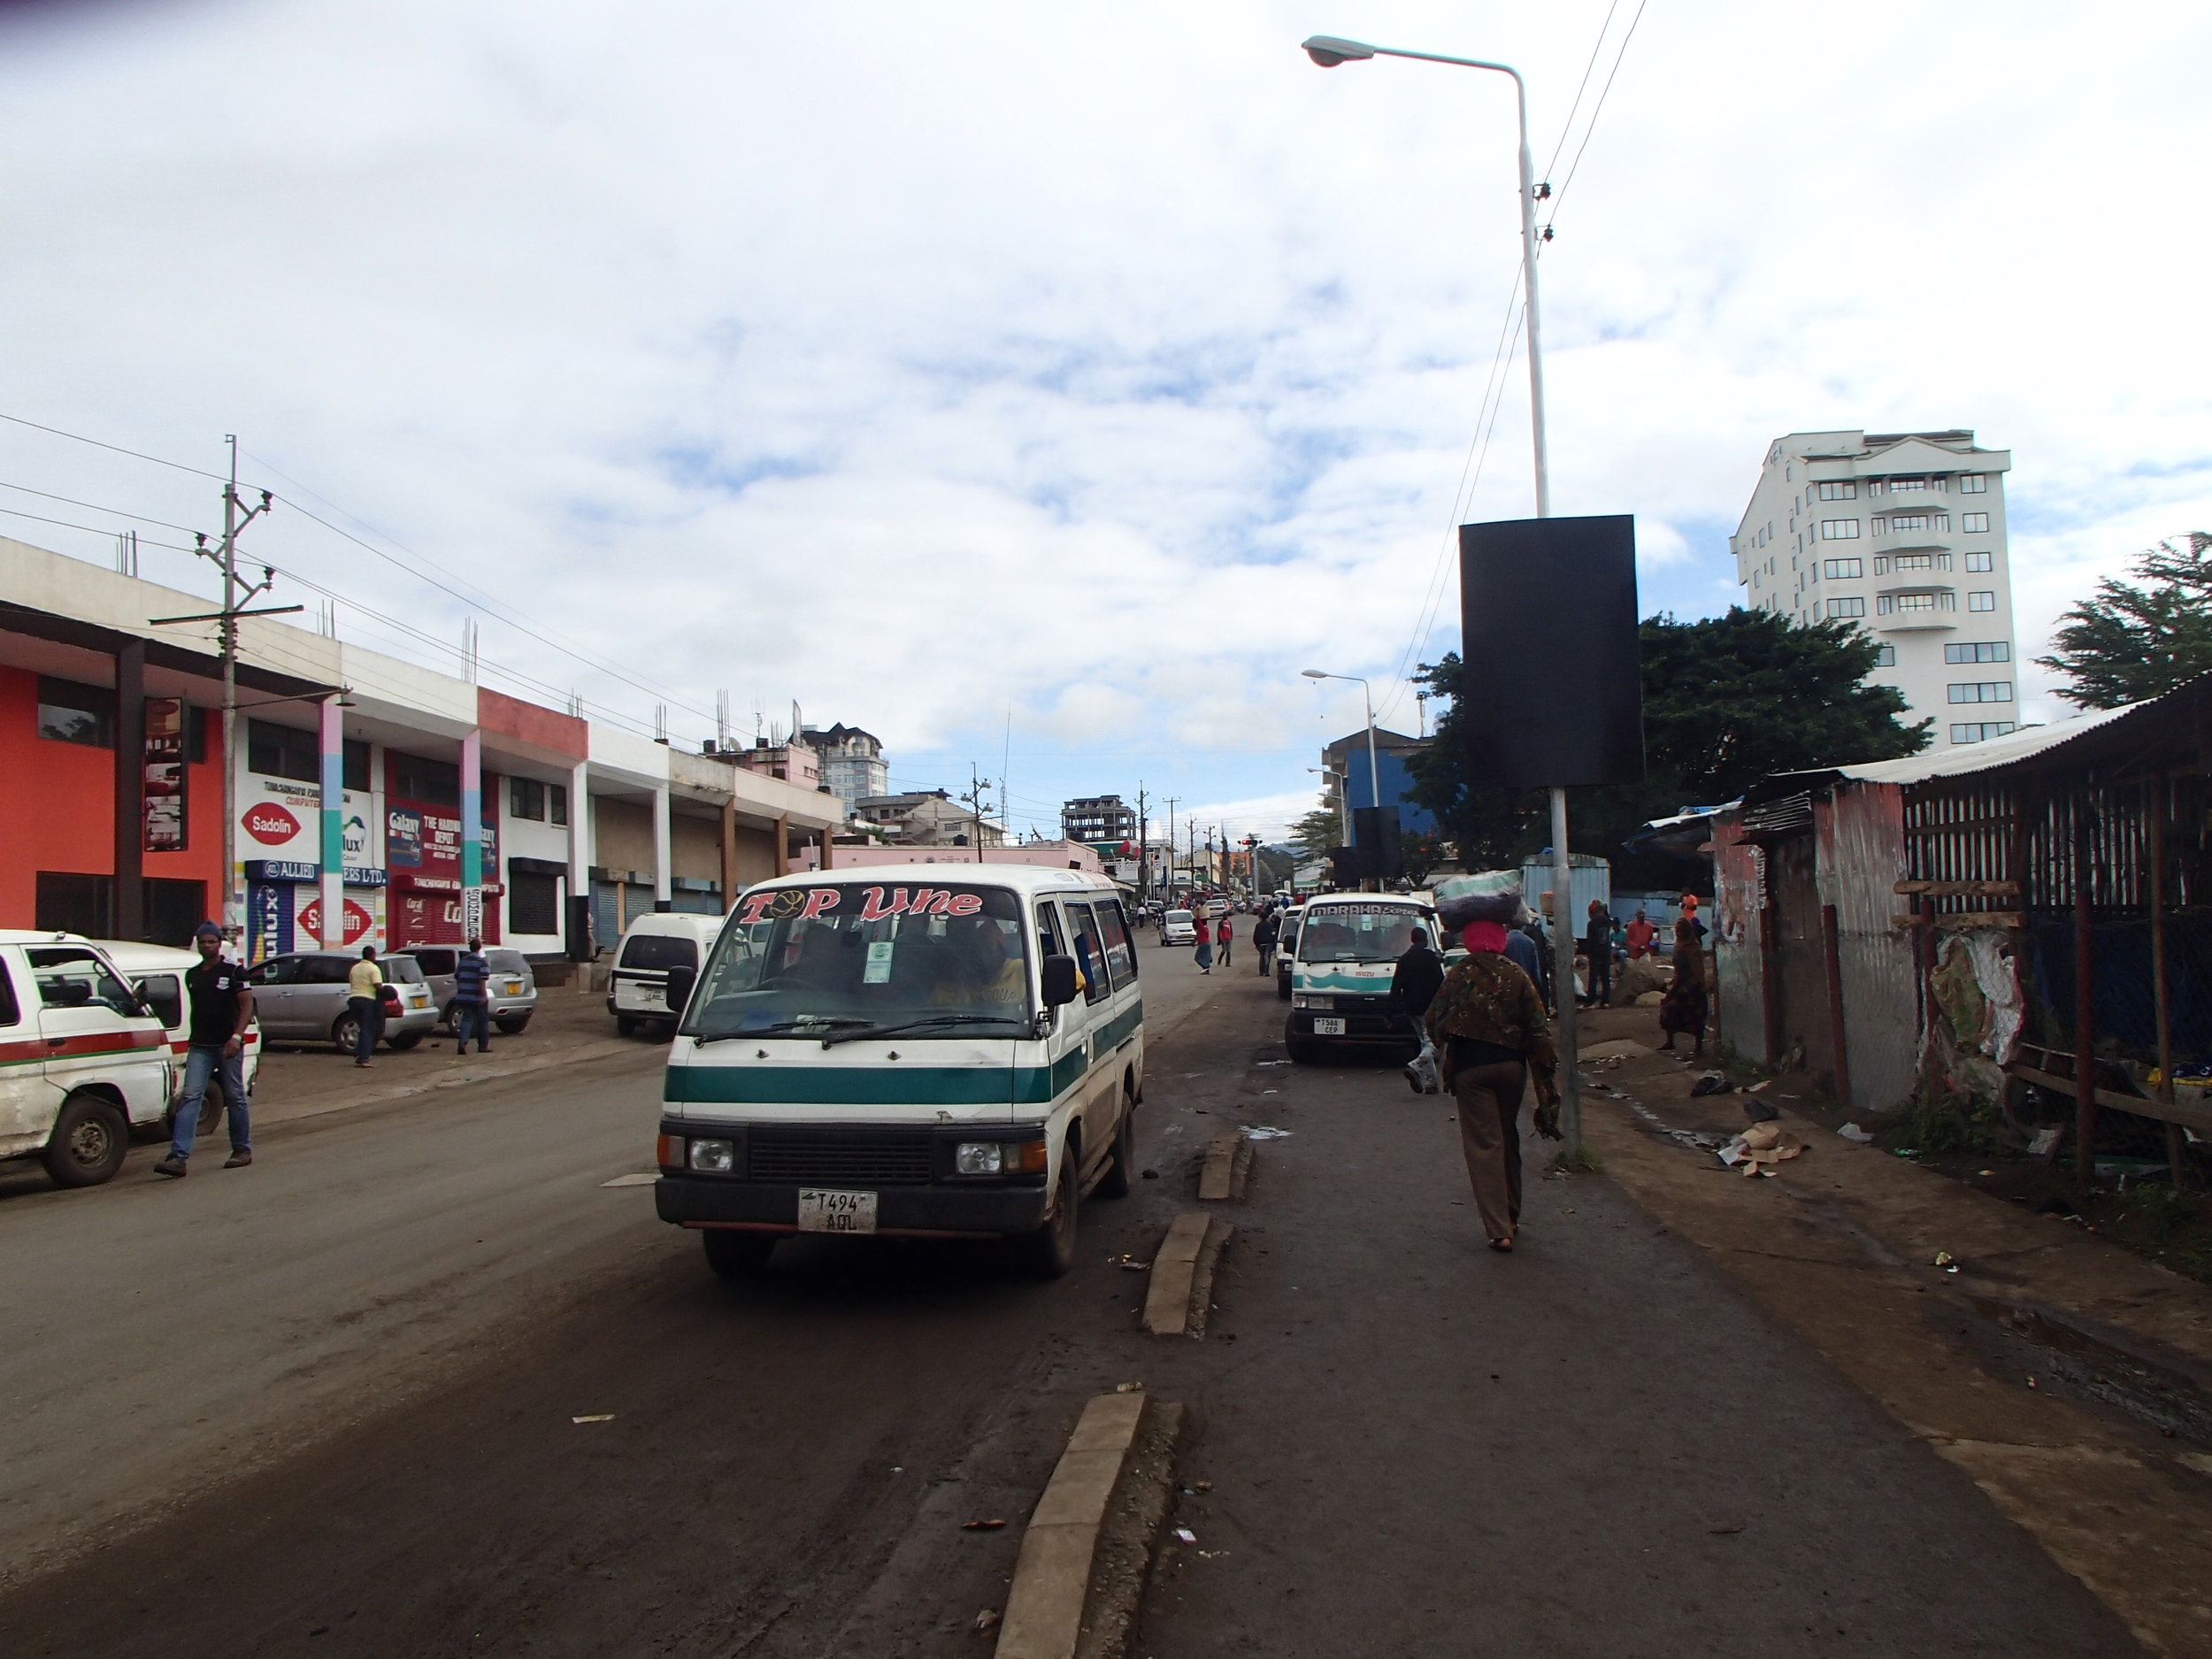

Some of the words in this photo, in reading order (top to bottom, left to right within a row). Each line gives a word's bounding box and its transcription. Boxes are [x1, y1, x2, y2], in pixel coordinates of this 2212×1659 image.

[252, 815, 291, 834] Sadolin
[424, 815, 437, 829] THE
[342, 834, 361, 852] lux
[281, 863, 315, 879] ALLIED
[343, 867, 361, 881] ERS
[363, 870, 387, 883] LTD.
[740, 888, 841, 924] TOP
[1310, 905, 1380, 917] MARAHA
[818, 1193, 857, 1212] T494
